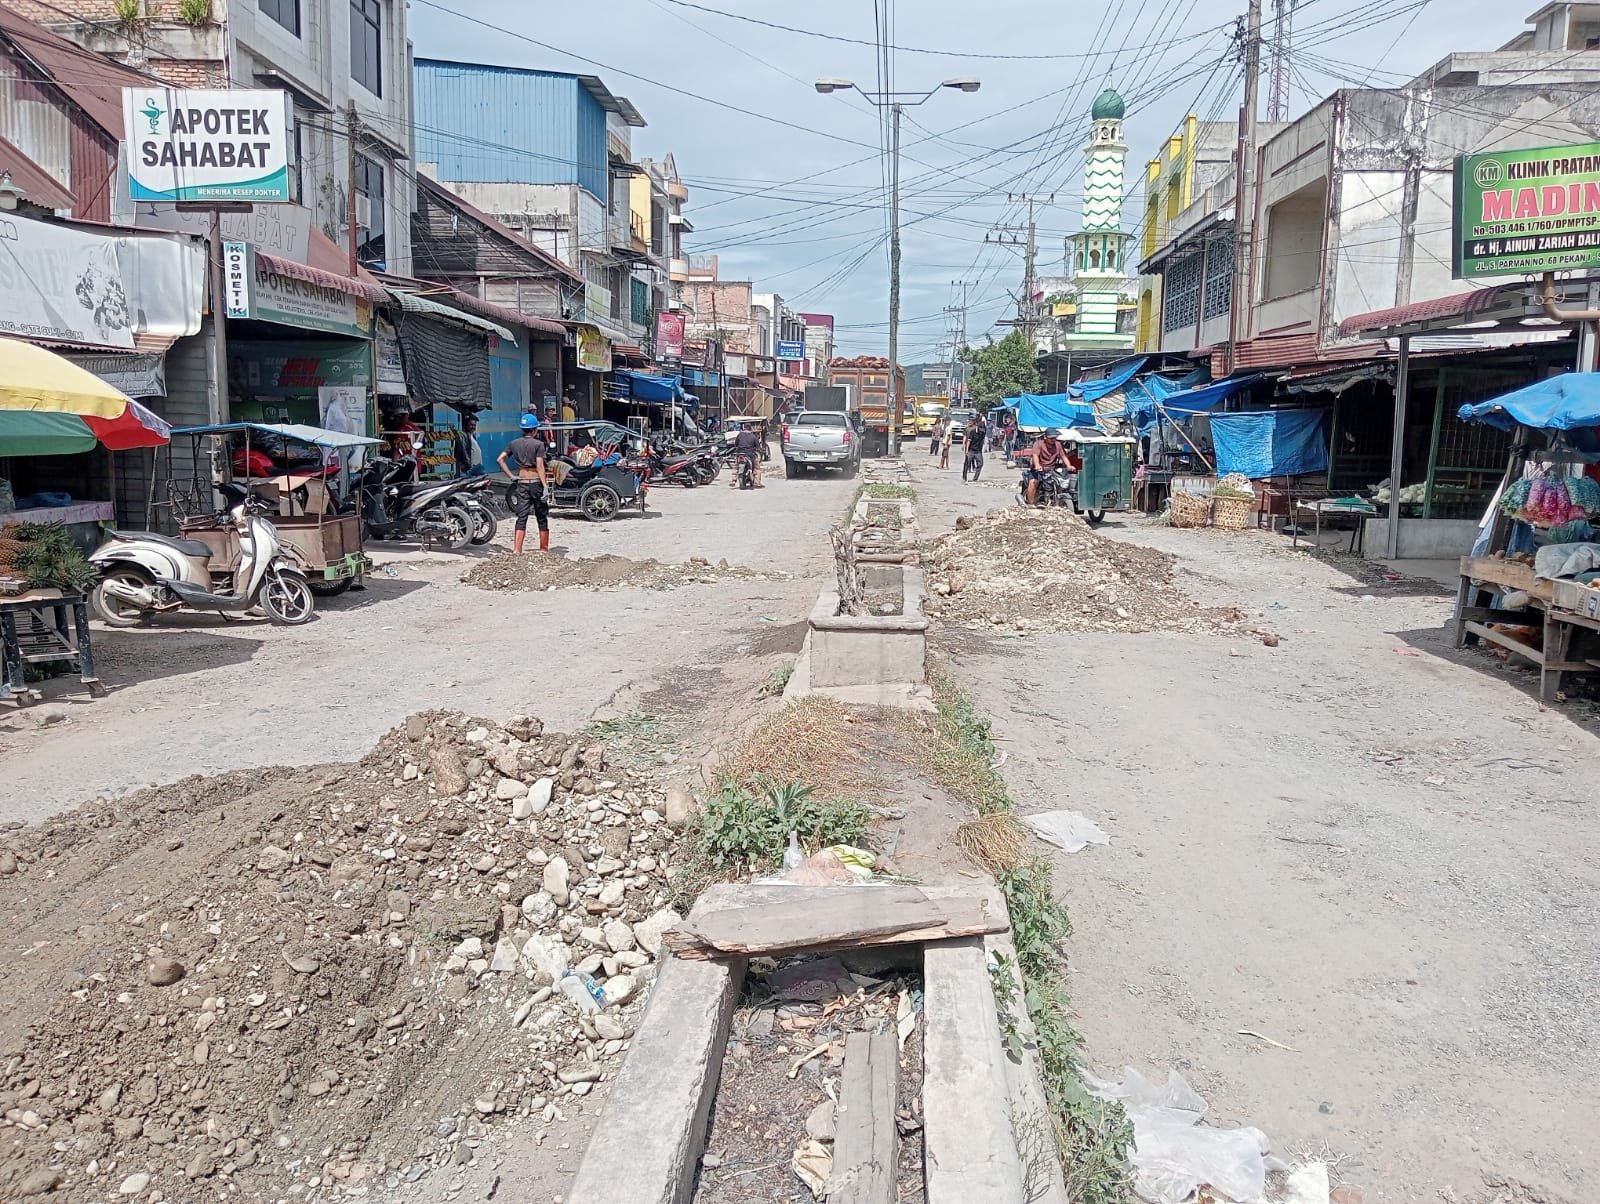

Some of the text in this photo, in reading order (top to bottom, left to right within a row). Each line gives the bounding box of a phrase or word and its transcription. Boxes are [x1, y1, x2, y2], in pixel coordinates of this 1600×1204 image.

[171, 108, 270, 135] APOTEK
[142, 141, 271, 168] SAHABAT
[1479, 167, 1499, 181] KM
[1507, 160, 1549, 180] KLINIK
[254, 189, 281, 197] DOKTER
[1473, 226, 1488, 236] No.
[1473, 243, 1486, 255] dr.
[1488, 242, 1502, 256] Hj.
[1505, 238, 1536, 253] AINUN
[1538, 235, 1575, 250] ZARIAH
[1476, 263, 1488, 271] JL.
[1499, 258, 1530, 268] PARMAN
[1559, 253, 1586, 264] PEKAN
[230, 245, 243, 315] KOSMETIK
[255, 271, 300, 297] APOTEK
[303, 282, 348, 307] SAHABAT
